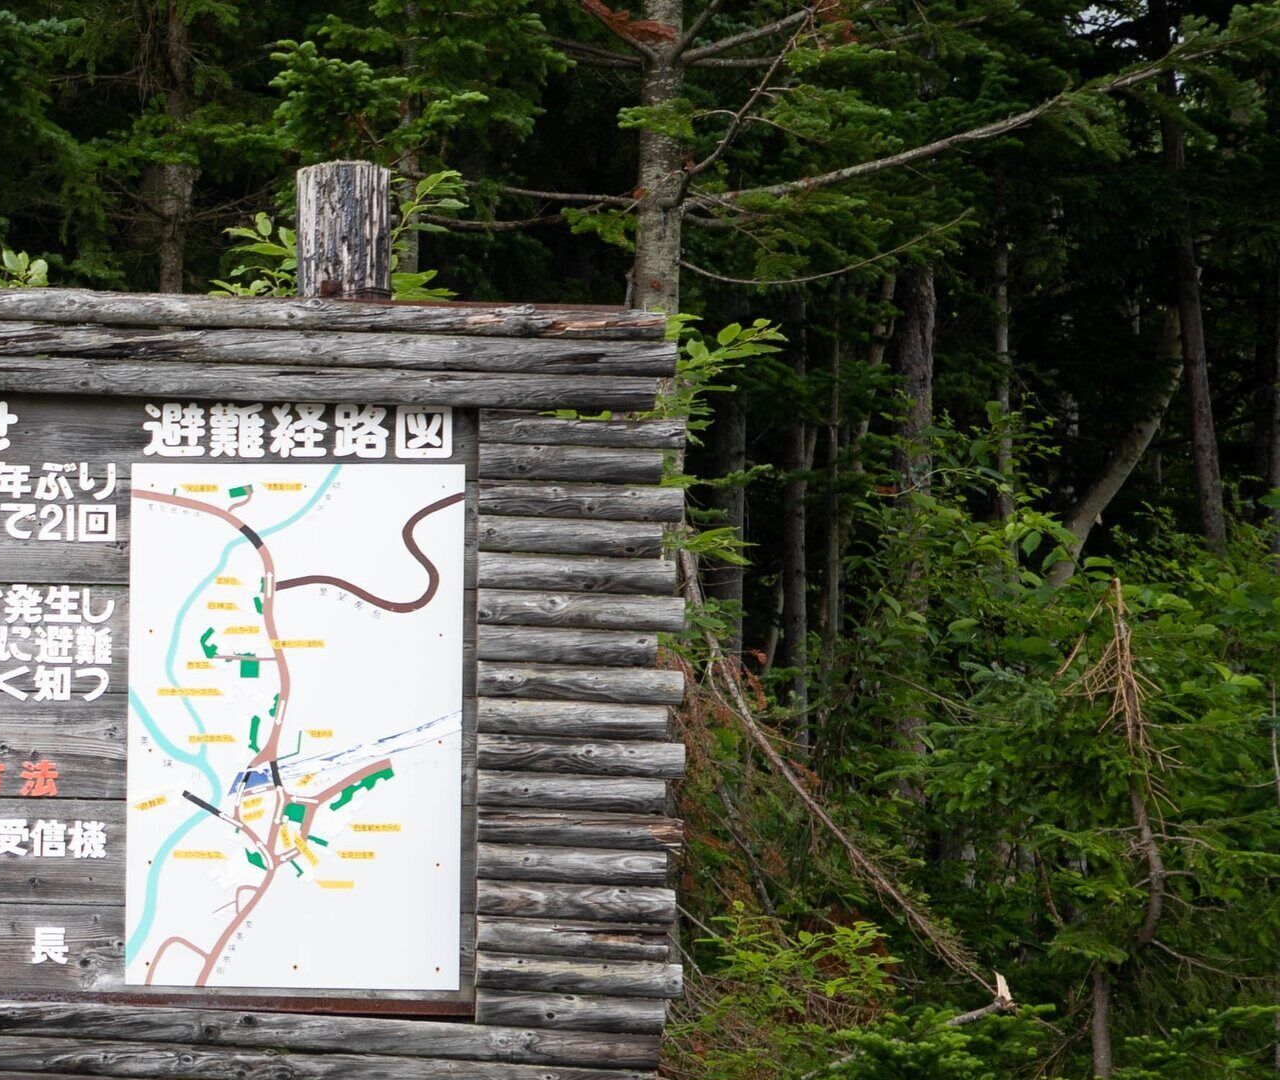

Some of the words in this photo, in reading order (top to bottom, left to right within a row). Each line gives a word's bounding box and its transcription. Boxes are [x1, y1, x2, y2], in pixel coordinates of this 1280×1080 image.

[143, 403, 452, 458] 避難経路図
